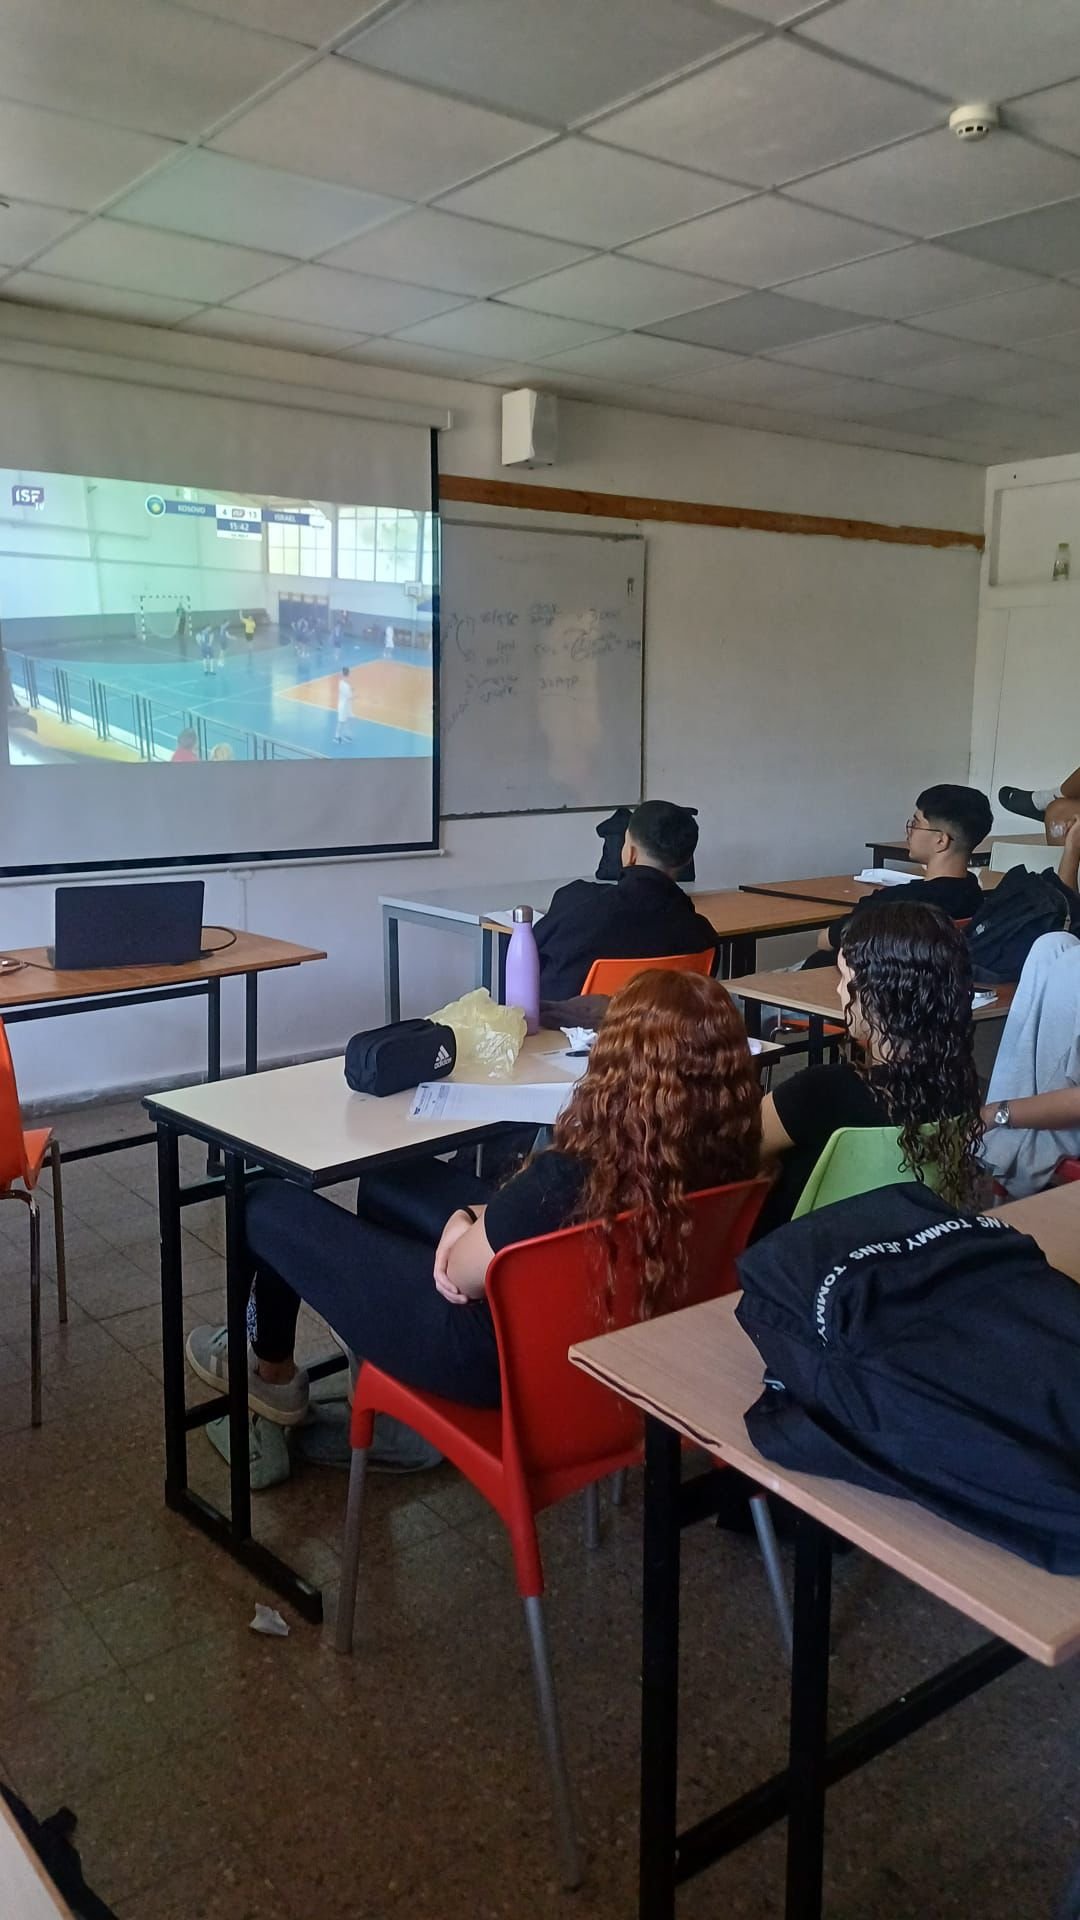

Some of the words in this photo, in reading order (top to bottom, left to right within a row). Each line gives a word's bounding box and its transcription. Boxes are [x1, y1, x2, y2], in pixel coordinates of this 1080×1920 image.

[15, 489, 40, 503] ISF
[178, 504, 206, 514] KOSOVO
[274, 513, 297, 522] ISRAEL
[907, 1217, 972, 1251] TOMMY
[849, 1241, 901, 1260] JEANS
[816, 1266, 847, 1342] TOMMY
